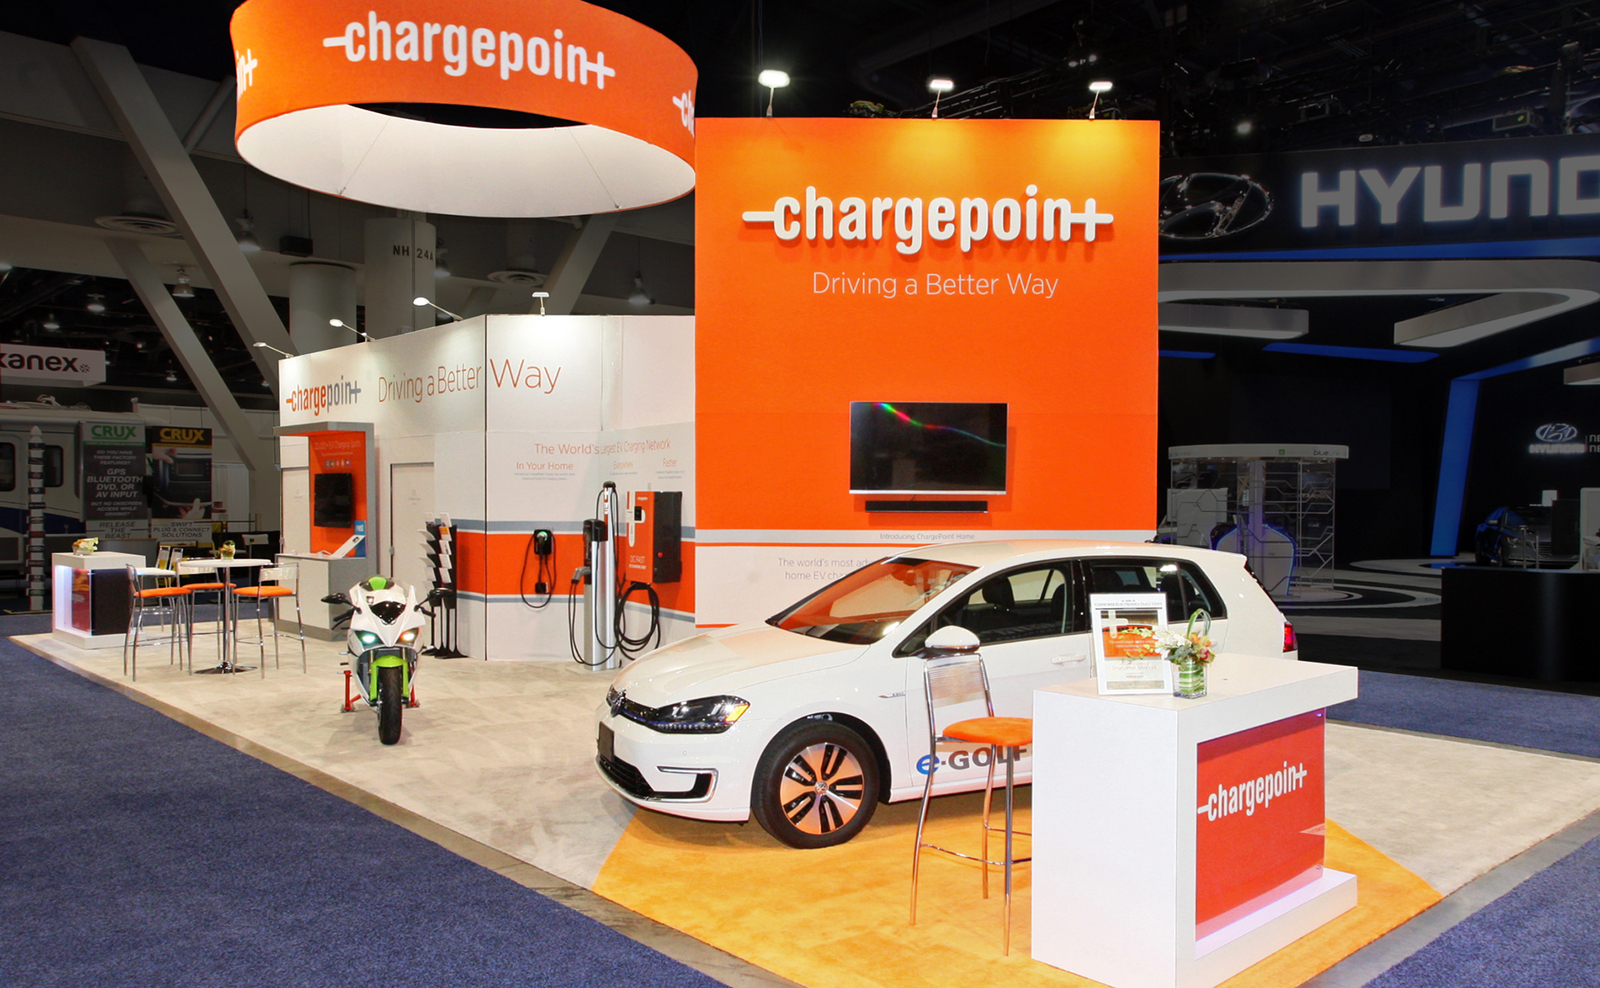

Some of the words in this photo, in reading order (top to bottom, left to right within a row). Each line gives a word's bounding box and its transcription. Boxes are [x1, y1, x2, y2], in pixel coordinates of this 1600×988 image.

[392, 244, 410, 256] NH
[416, 248, 434, 261] 24A
[813, 272, 897, 299] Driving
[904, 277, 918, 296] a
[926, 272, 999, 296] Better
[1006, 273, 1059, 299] Way
[379, 374, 423, 403] Driving
[427, 374, 435, 396] a
[438, 365, 482, 394] Better
[489, 358, 562, 394] Way
[91, 425, 136, 438] CRUX
[160, 428, 204, 441] CRUX
[534, 443, 554, 454] The
[558, 444, 600, 455] World's
[624, 441, 645, 453] Charging
[646, 438, 670, 450] Network
[516, 462, 524, 470] In
[526, 462, 545, 470] Your
[548, 462, 574, 470] Home
[778, 558, 794, 567] The
[796, 558, 829, 567] world's
[831, 559, 854, 567] most
[856, 558, 873, 567] adv
[785, 571, 811, 580] home
[814, 572, 826, 580] EV
[828, 571, 846, 580] cha
